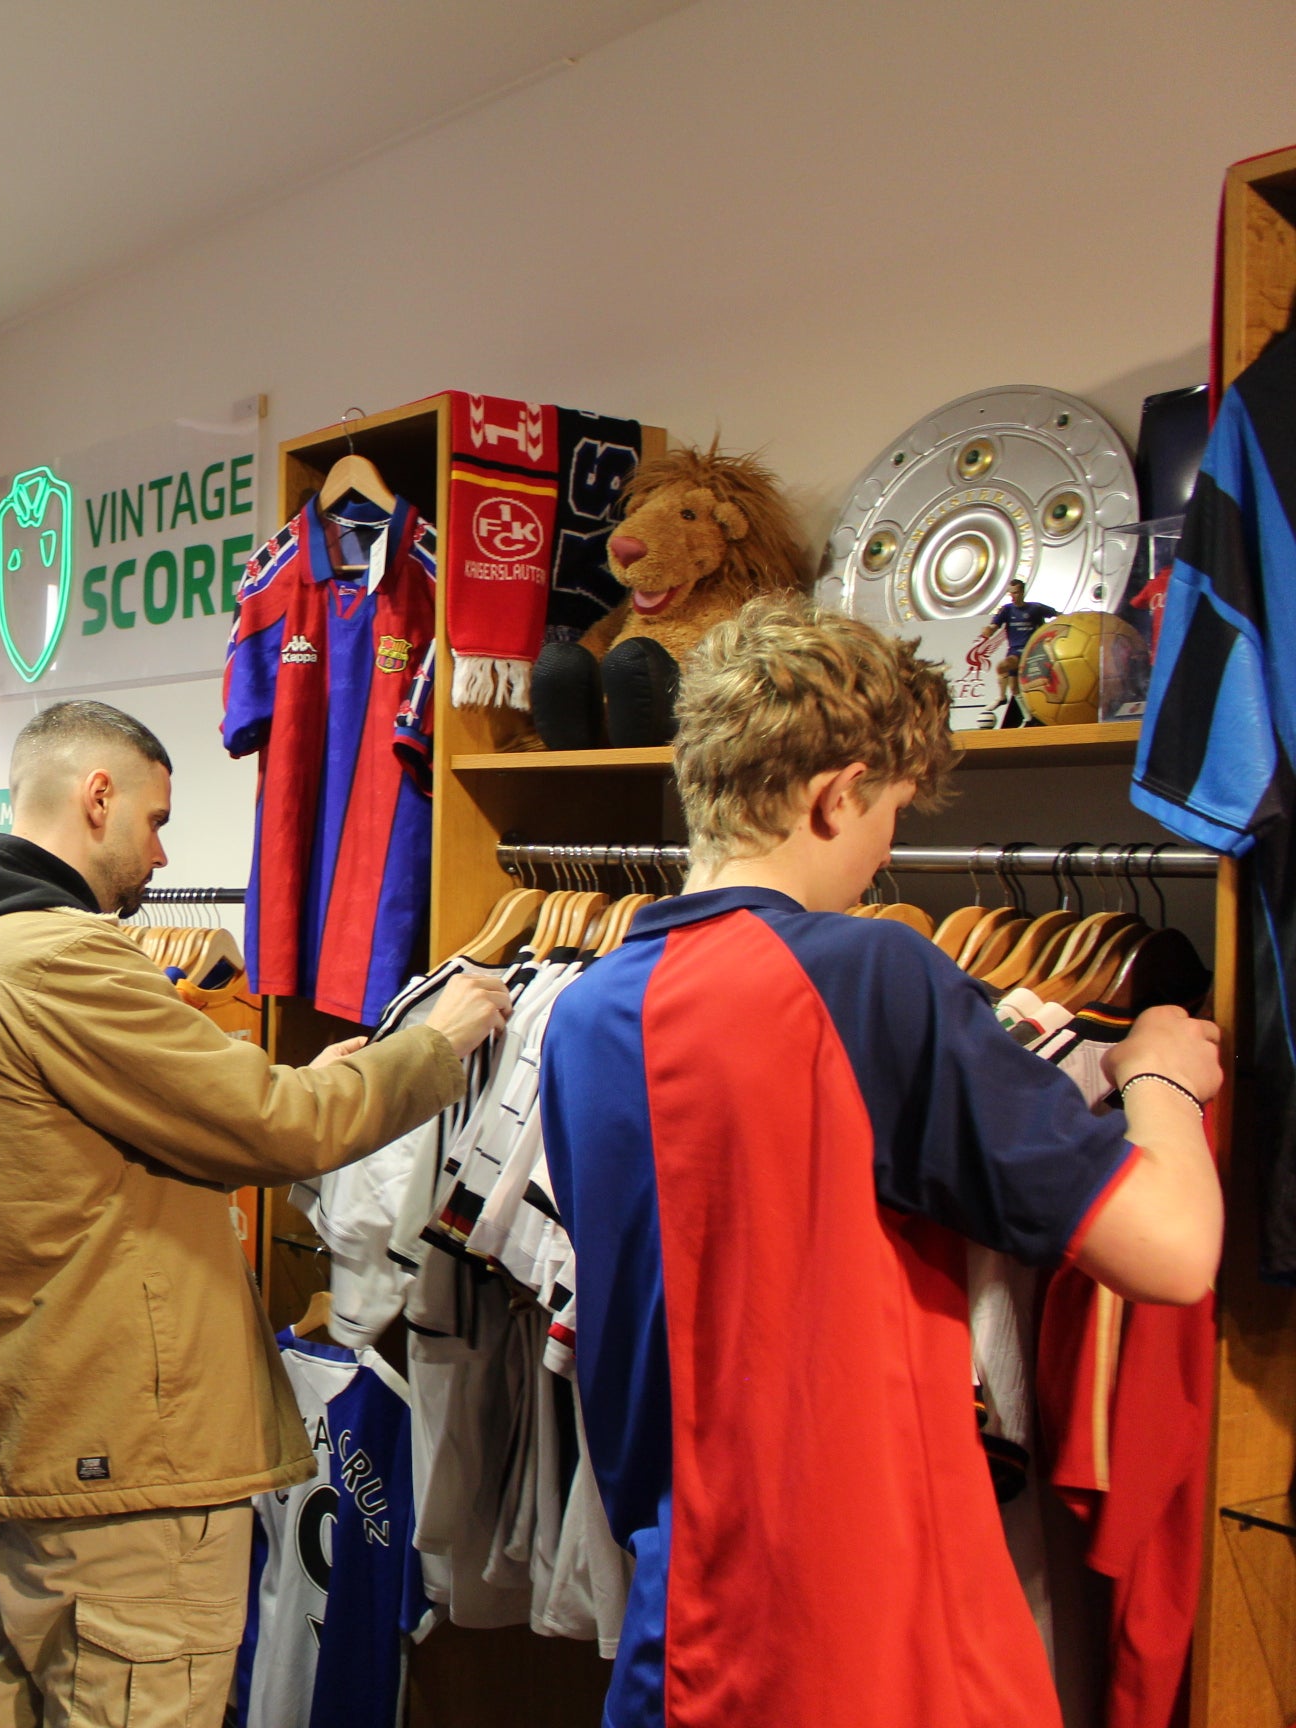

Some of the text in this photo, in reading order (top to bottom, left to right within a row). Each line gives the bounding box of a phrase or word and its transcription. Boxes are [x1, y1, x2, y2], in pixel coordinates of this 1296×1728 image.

[85, 453, 254, 549] VINTAGE
[81, 533, 255, 637] SCORE
[281, 652, 318, 664] Kappa
